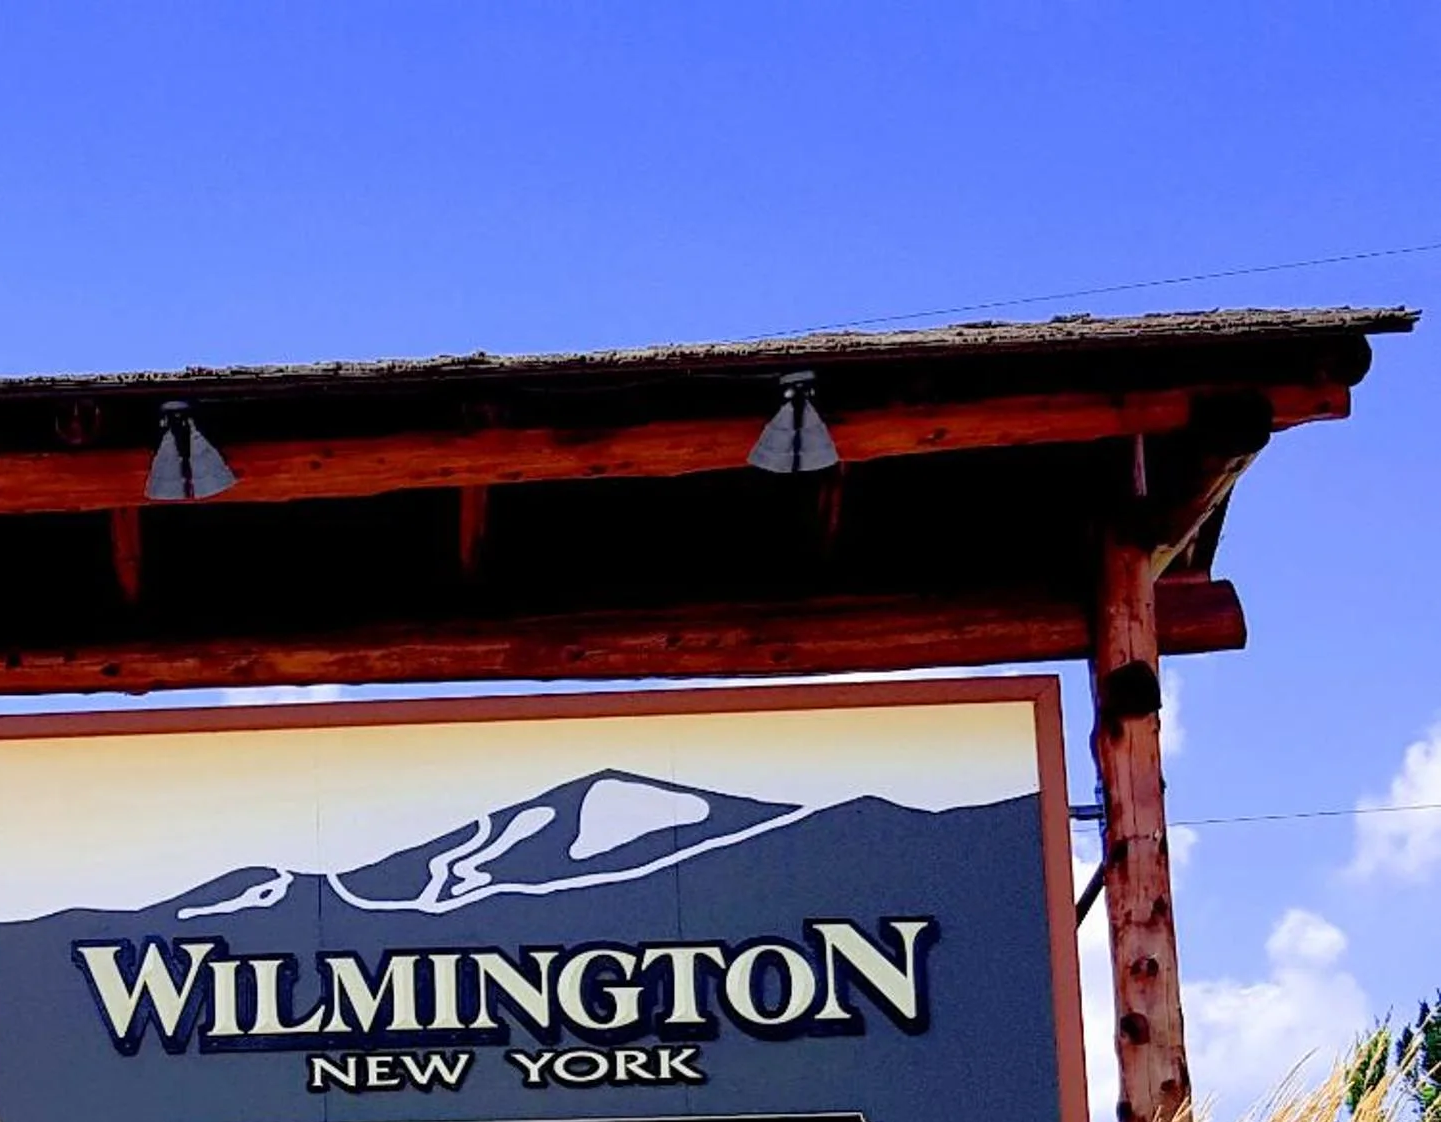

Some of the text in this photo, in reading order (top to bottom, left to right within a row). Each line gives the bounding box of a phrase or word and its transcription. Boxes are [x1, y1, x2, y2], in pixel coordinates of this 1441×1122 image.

[75, 919, 931, 1039] WILMINGTON
[311, 1047, 701, 1087] NEW YORK
